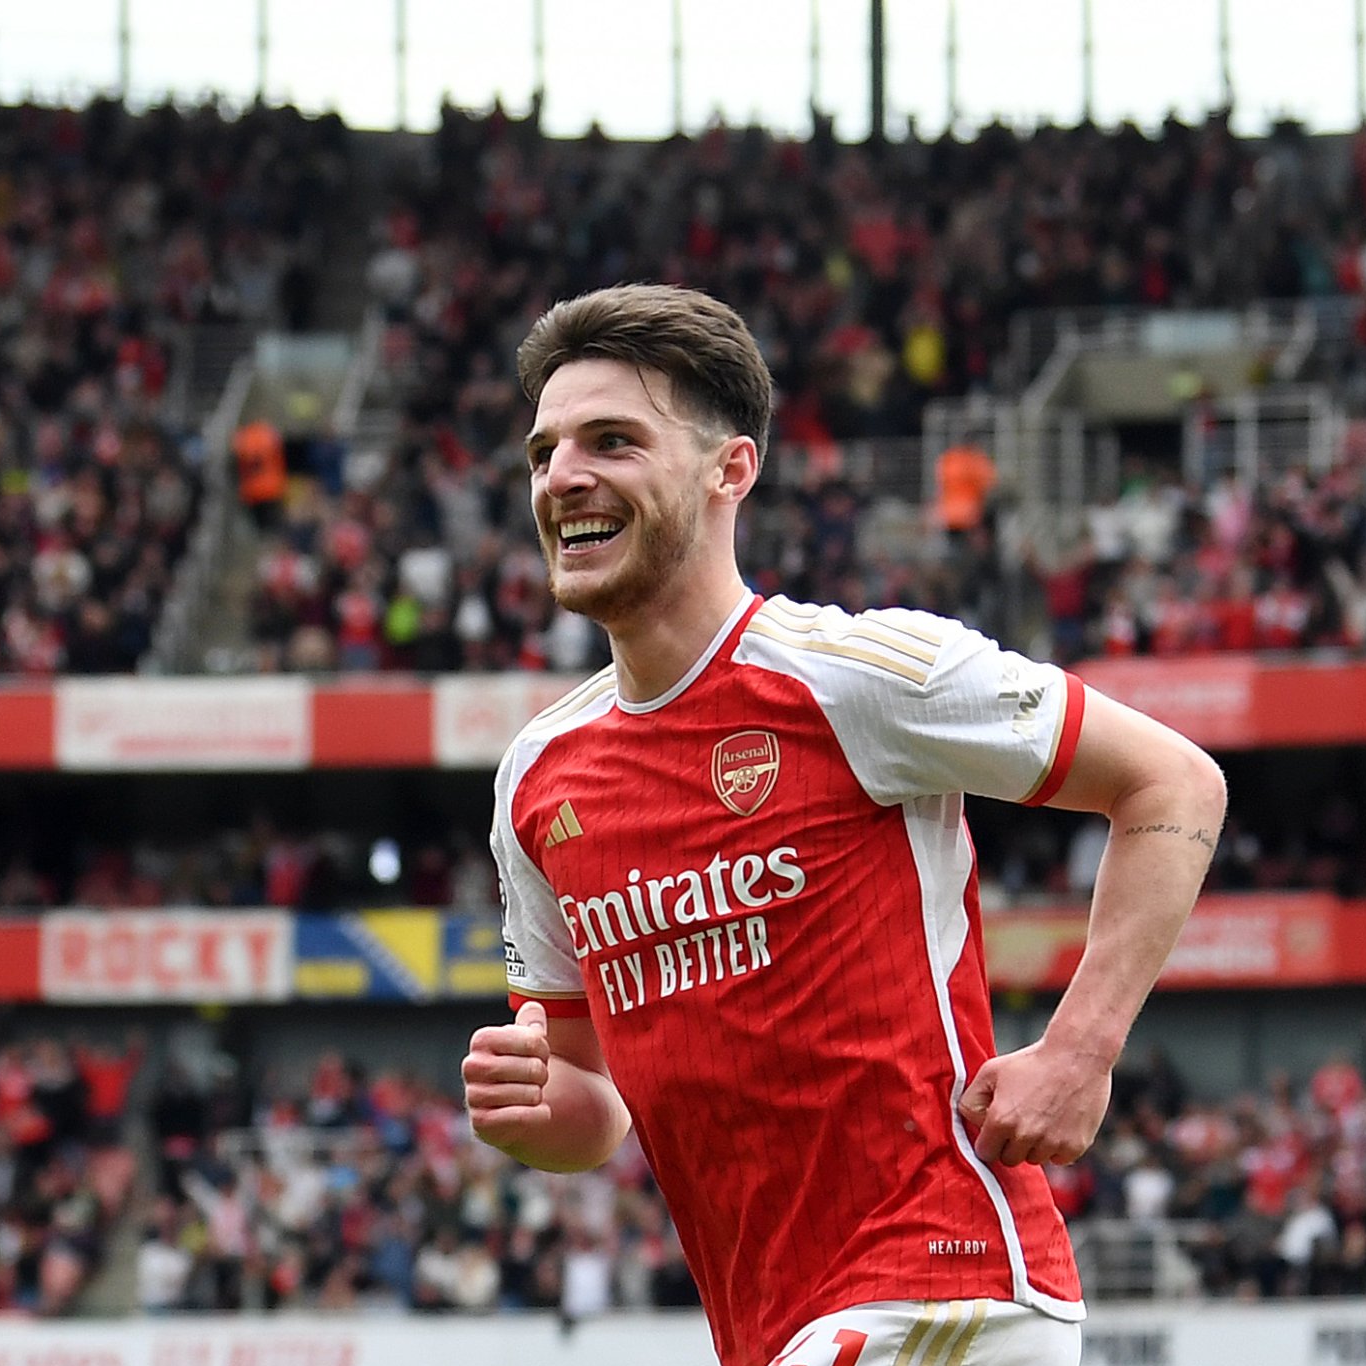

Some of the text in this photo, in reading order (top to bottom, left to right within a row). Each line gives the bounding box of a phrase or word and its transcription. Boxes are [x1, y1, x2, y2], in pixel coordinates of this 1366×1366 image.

[721, 743, 769, 766] Arsenal
[557, 846, 807, 960] Emirates
[58, 925, 277, 983] ROCKY
[598, 952, 646, 1016] FLY
[654, 915, 773, 998] BETTER
[928, 1240, 988, 1256] HEAT.RDY
